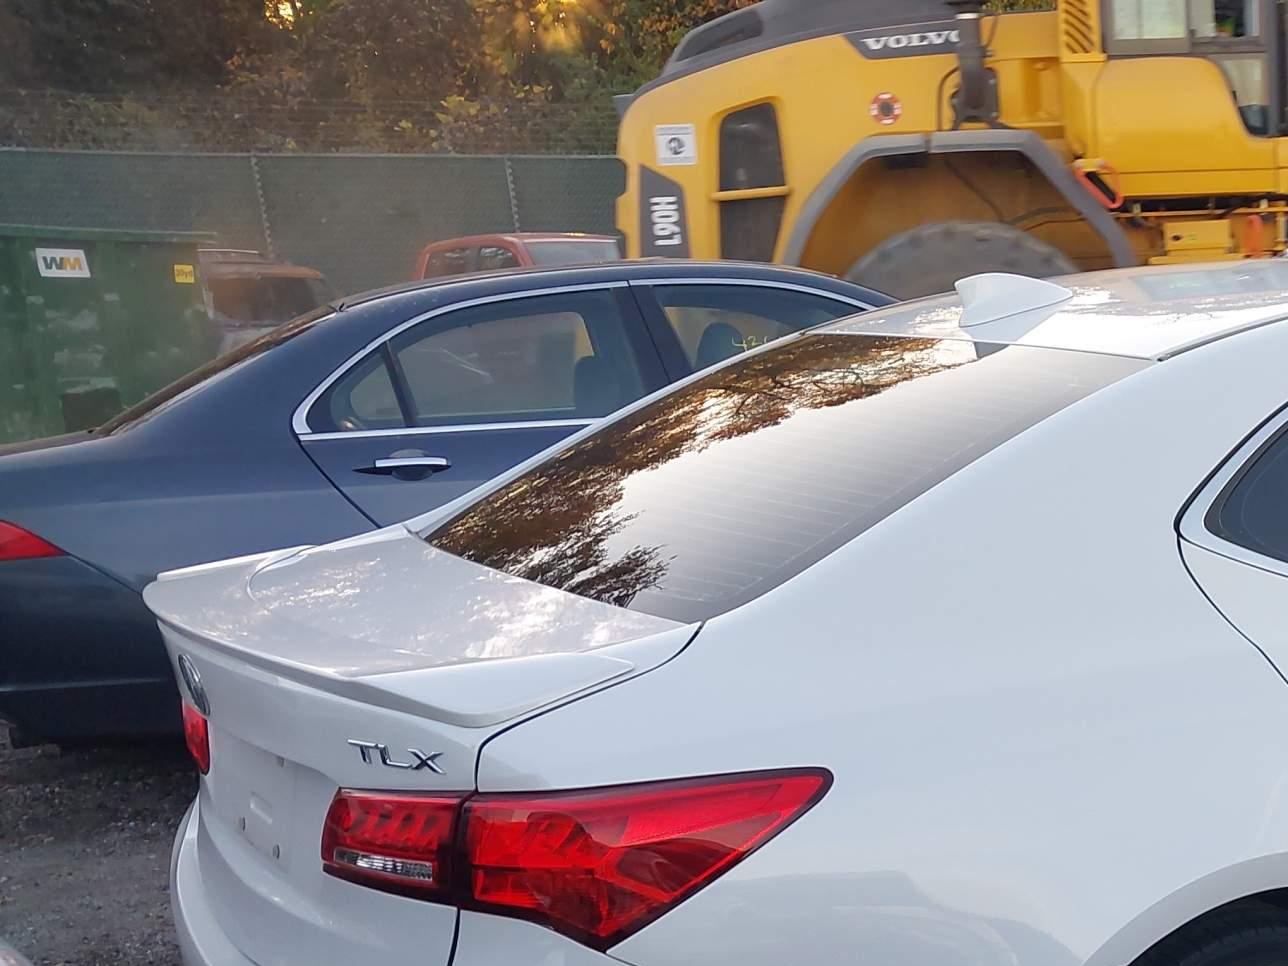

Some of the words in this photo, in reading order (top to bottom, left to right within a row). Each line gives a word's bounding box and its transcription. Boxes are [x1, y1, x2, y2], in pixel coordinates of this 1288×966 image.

[649, 196, 682, 246] L90H
[42, 255, 83, 271] WM
[347, 738, 447, 775] TLX
